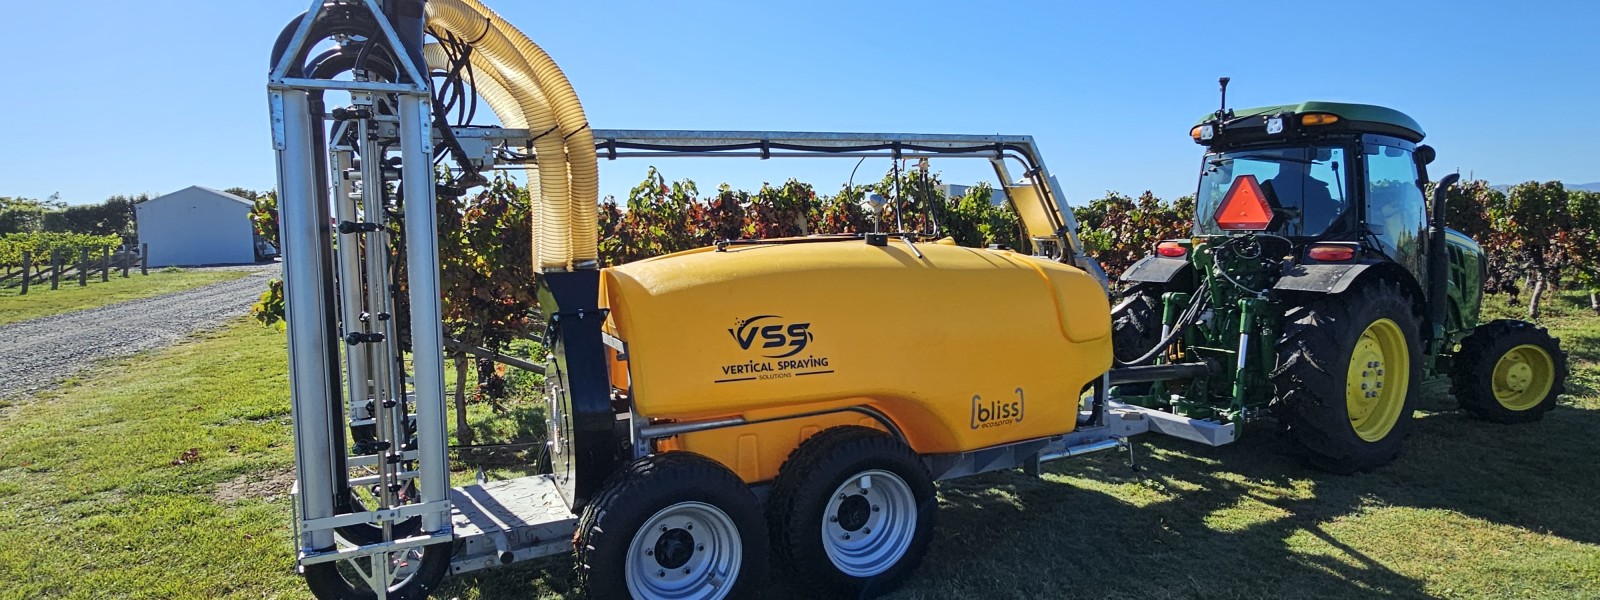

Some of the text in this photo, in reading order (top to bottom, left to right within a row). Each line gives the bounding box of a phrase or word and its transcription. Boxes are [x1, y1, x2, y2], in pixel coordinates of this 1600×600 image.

[728, 320, 813, 354] VSS
[722, 355, 829, 375] VERTICAL SPRAYING
[759, 372, 792, 381] SOLUTIONS
[981, 418, 1014, 429] ecospray
